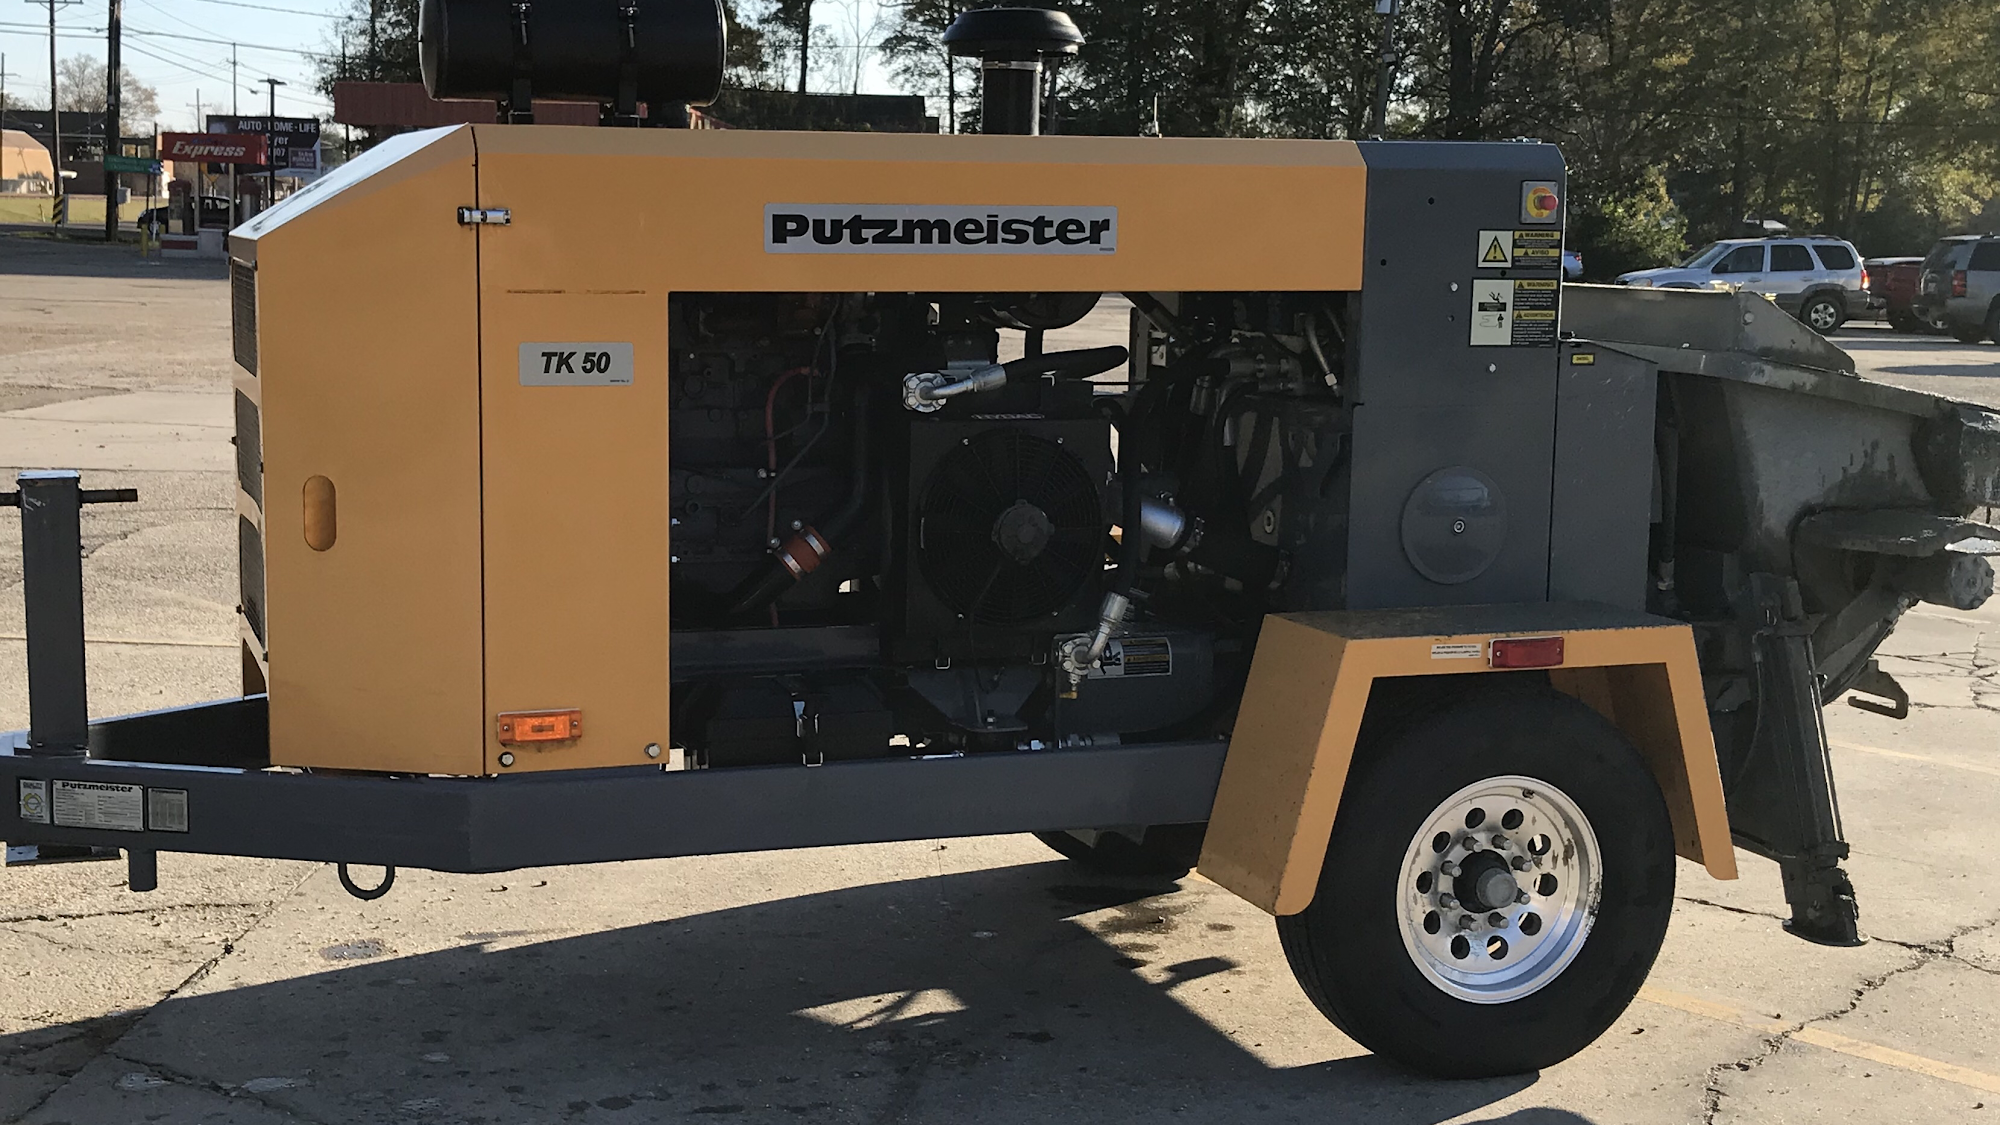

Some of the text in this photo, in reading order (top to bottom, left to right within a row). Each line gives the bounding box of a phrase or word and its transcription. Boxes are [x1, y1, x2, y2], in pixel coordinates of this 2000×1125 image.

[238, 120, 262, 131] AUTO
[299, 123, 317, 133] LIFE
[172, 141, 246, 158] Express
[772, 213, 1110, 245] Putzmeister
[541, 351, 611, 374] TK 50
[61, 781, 134, 793] Putzmeister
